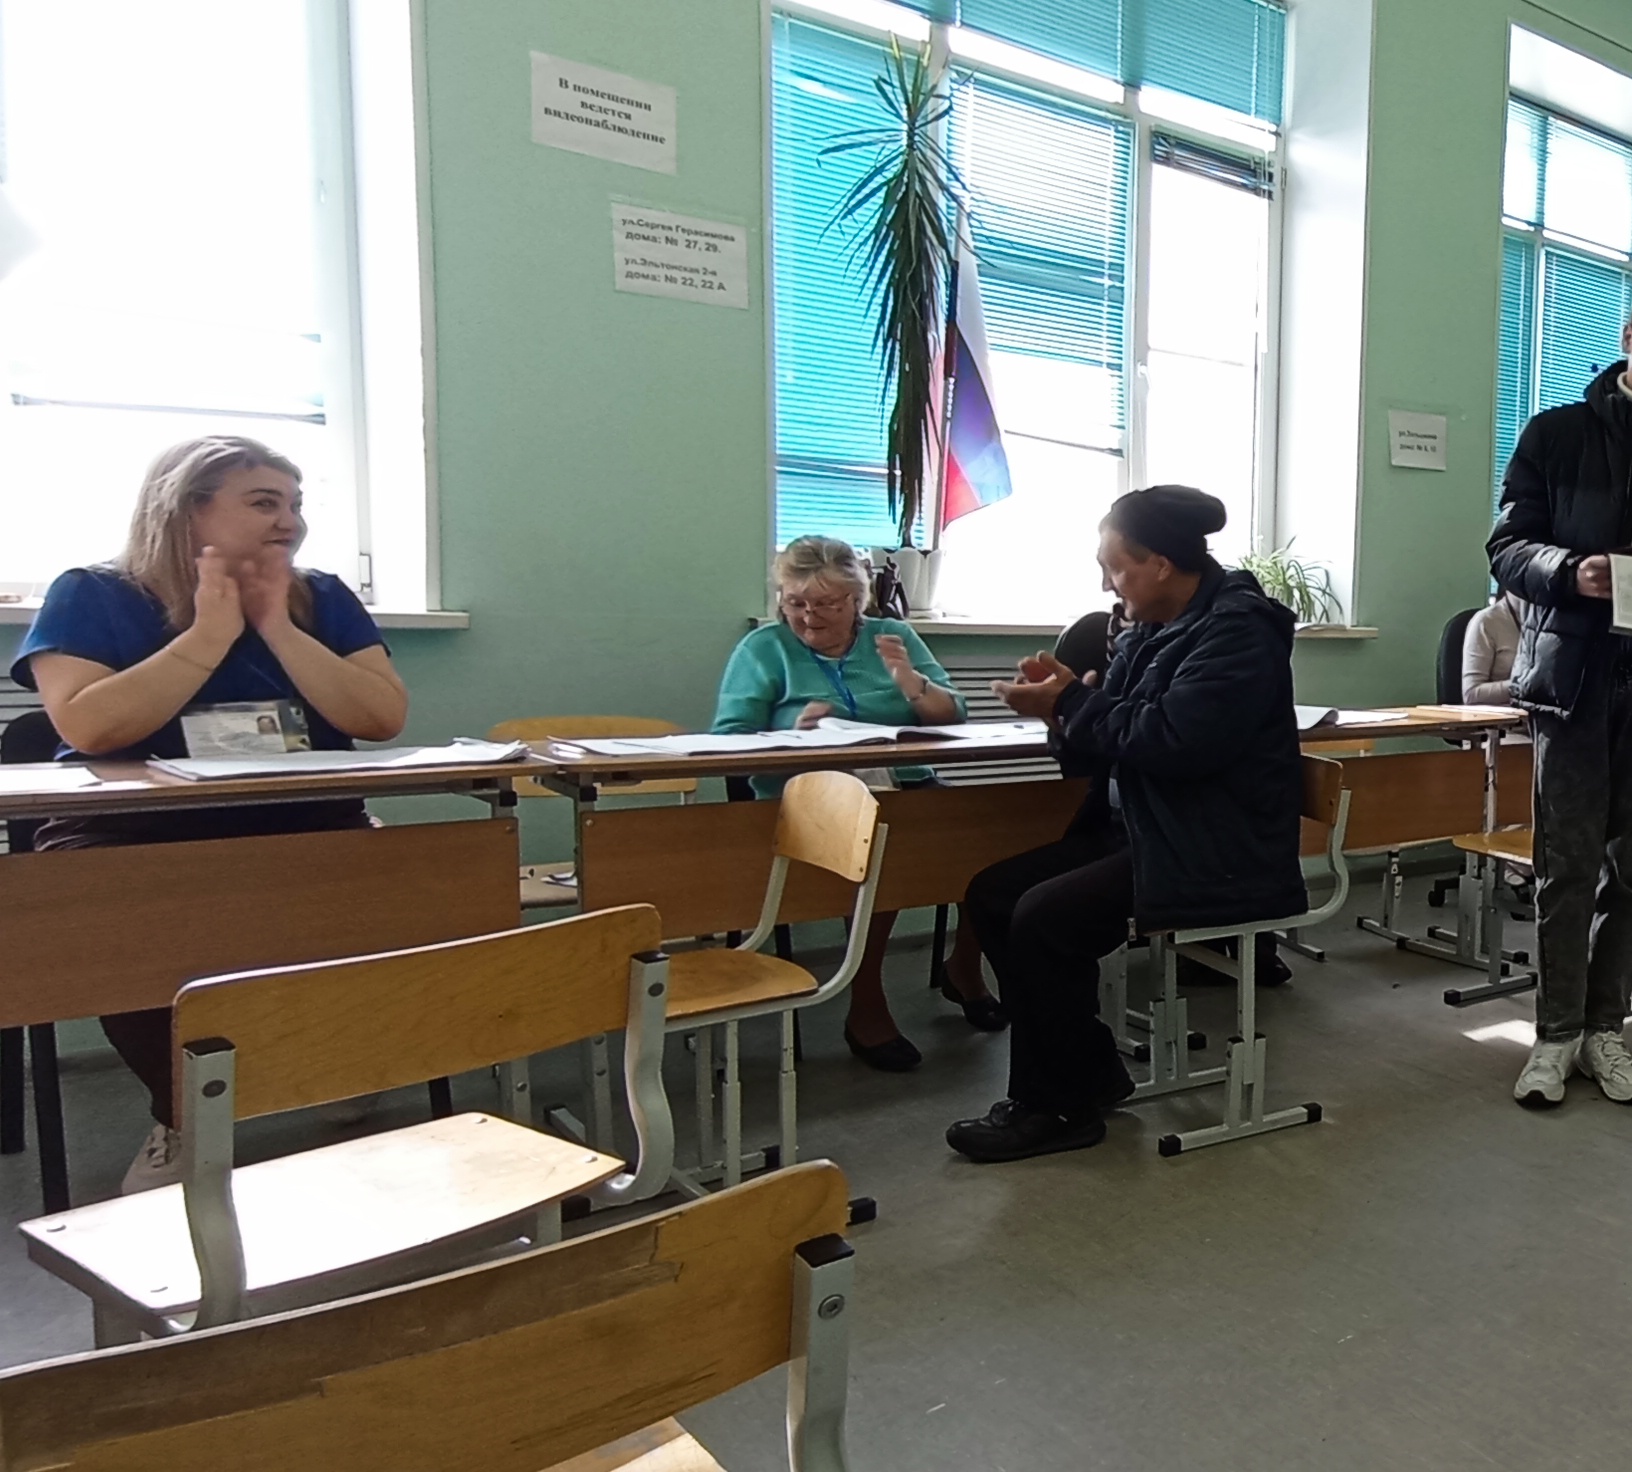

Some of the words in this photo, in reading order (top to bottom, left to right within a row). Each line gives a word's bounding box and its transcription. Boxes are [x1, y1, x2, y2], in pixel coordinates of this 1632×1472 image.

[558, 77, 569, 90] В
[572, 83, 652, 112] помещении
[580, 100, 632, 121] ведется
[543, 106, 667, 145] видеонаблюдение
[701, 279, 714, 290] 22
